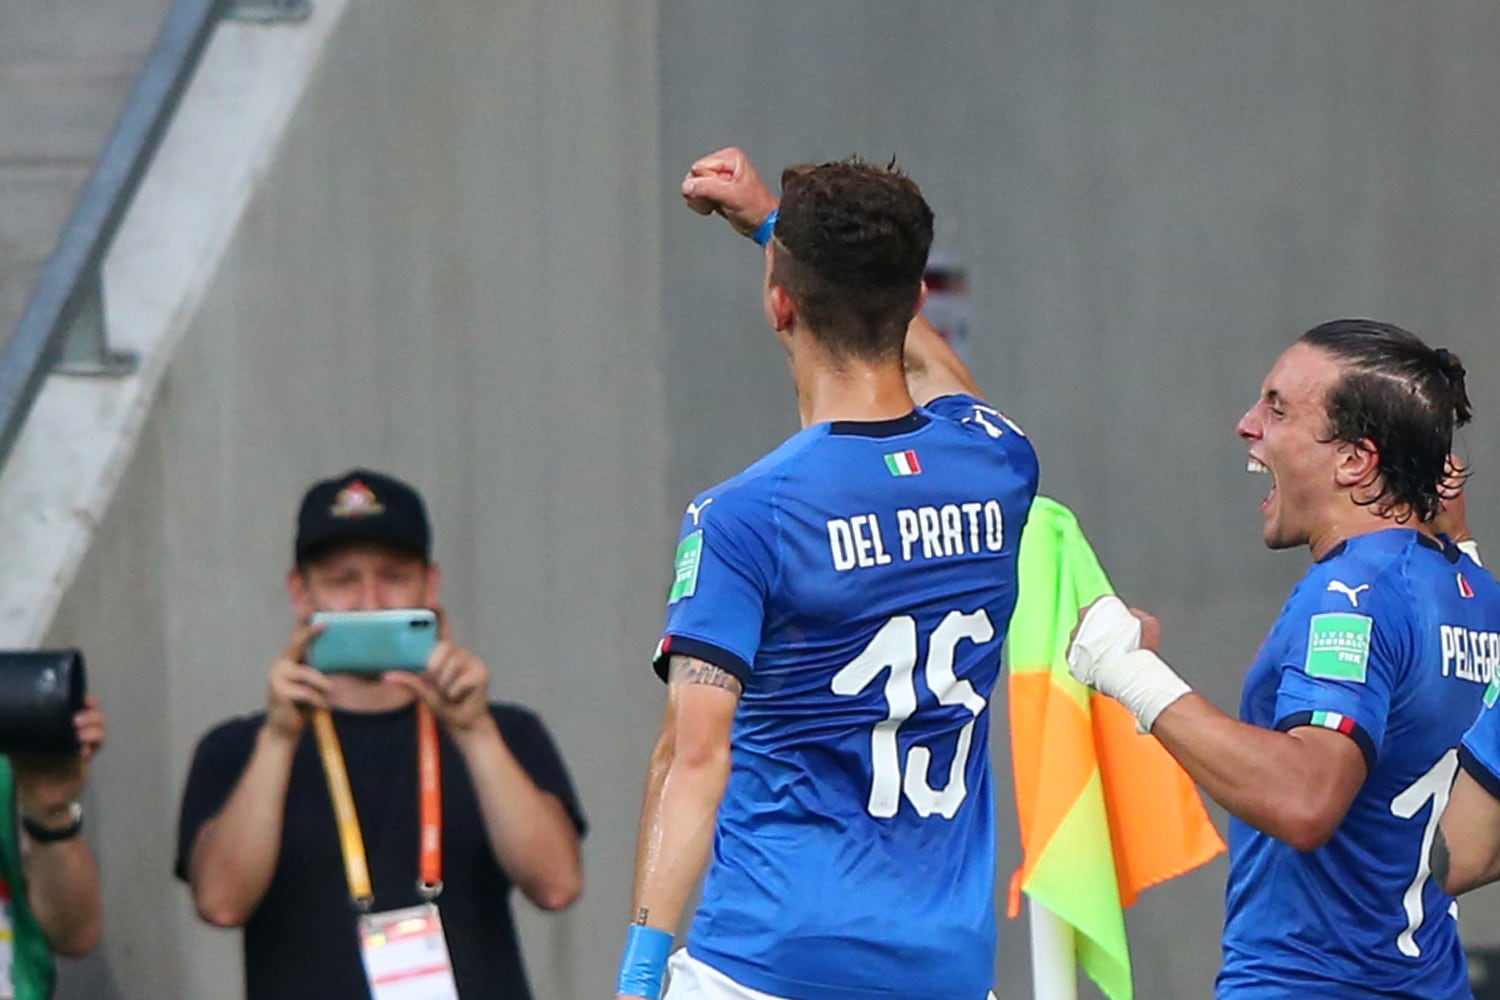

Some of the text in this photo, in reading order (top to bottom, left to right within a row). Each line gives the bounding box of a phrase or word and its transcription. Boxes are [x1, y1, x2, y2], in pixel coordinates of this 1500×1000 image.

[827, 500, 1004, 571] DEL PRATO
[831, 608, 995, 820] 15
